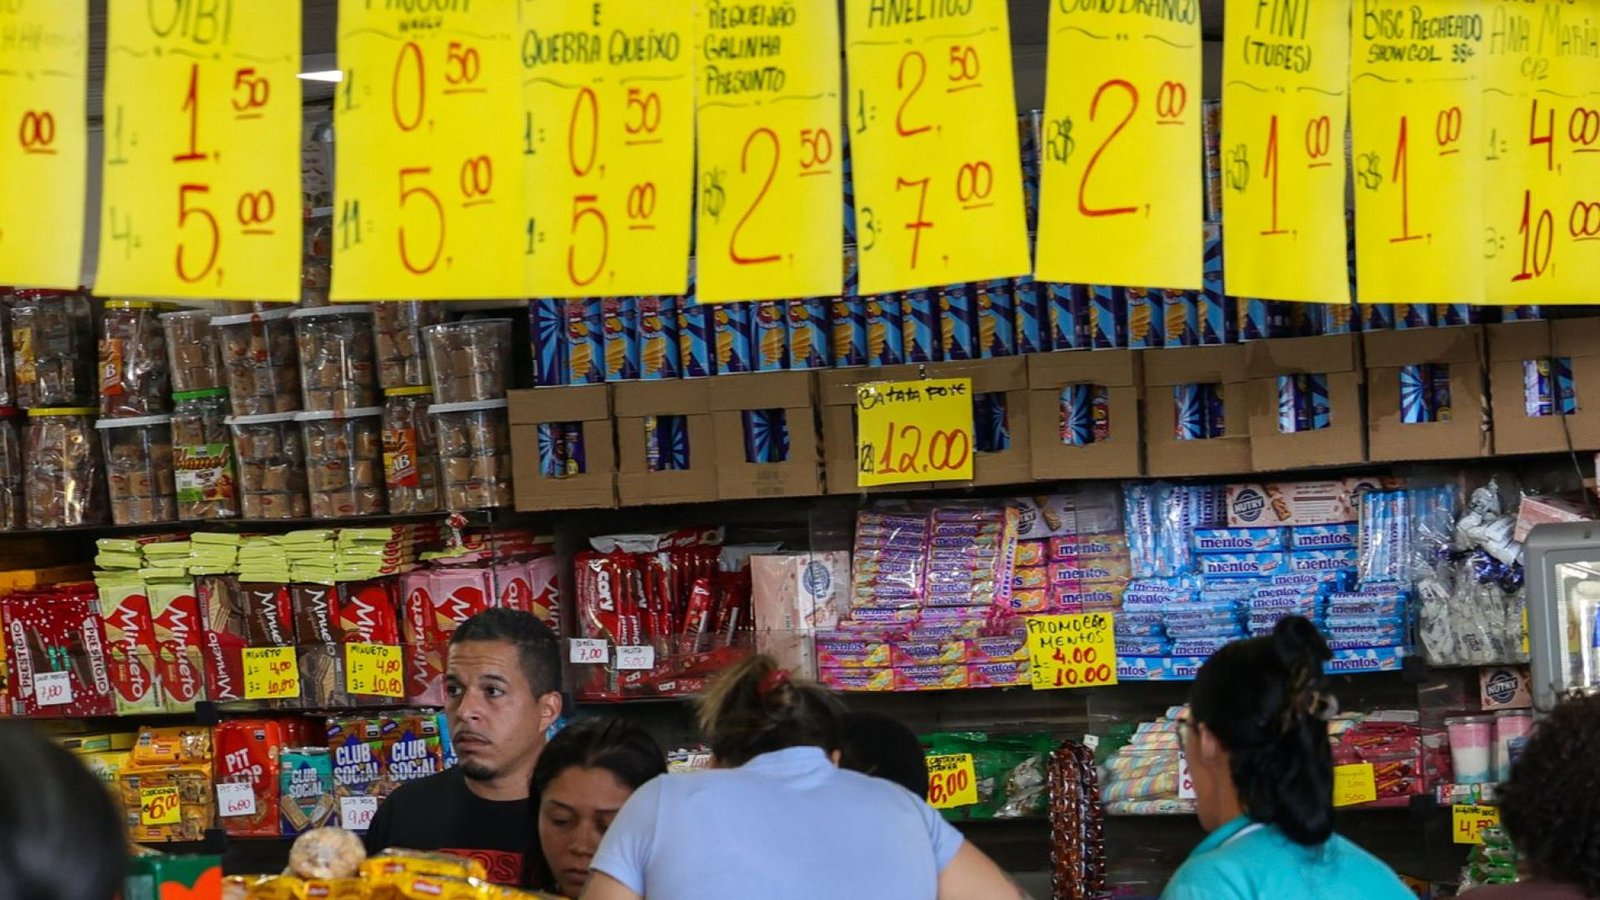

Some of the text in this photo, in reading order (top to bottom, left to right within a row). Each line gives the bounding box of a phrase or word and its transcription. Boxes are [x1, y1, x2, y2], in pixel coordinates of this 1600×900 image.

[592, 3, 600, 26] E
[1254, 0, 1310, 39] FINI
[1410, 5, 1483, 42] RECHEADO
[1489, 5, 1531, 55] ANA
[522, 28, 680, 68] QUEBRA QUEIXO
[704, 35, 781, 61] GALINHA
[1243, 36, 1313, 73] (TUBES)
[706, 65, 785, 95] PRESUNTO
[1060, 542, 1111, 554] mentos
[1200, 536, 1253, 548] mentos
[1299, 533, 1350, 546] mentos
[1059, 568, 1110, 579] mentos
[1208, 561, 1259, 573] mentos
[1297, 557, 1348, 570] mentos
[1275, 573, 1318, 585] mentos
[1063, 592, 1113, 603] mentos
[1253, 598, 1296, 608] mentos
[1257, 587, 1300, 599] mentos
[305, 588, 338, 656] Minueto
[117, 604, 145, 698] Minueto
[166, 604, 195, 698] Minueto
[351, 645, 389, 657] MINUETO
[411, 590, 429, 690] Minueto
[12, 622, 31, 689] PRESTIGIO
[86, 626, 107, 692] PRESTIGIO
[208, 633, 238, 700] Minueto
[1332, 658, 1378, 670] mentos
[336, 743, 371, 766] CLUB
[392, 739, 427, 762] CLUB
[292, 767, 317, 784] CLUB
[334, 761, 380, 786] SOCIAL
[390, 758, 437, 782] SOCIAL
[289, 781, 323, 798] SOCIAL
[930, 769, 968, 803] 6,00
